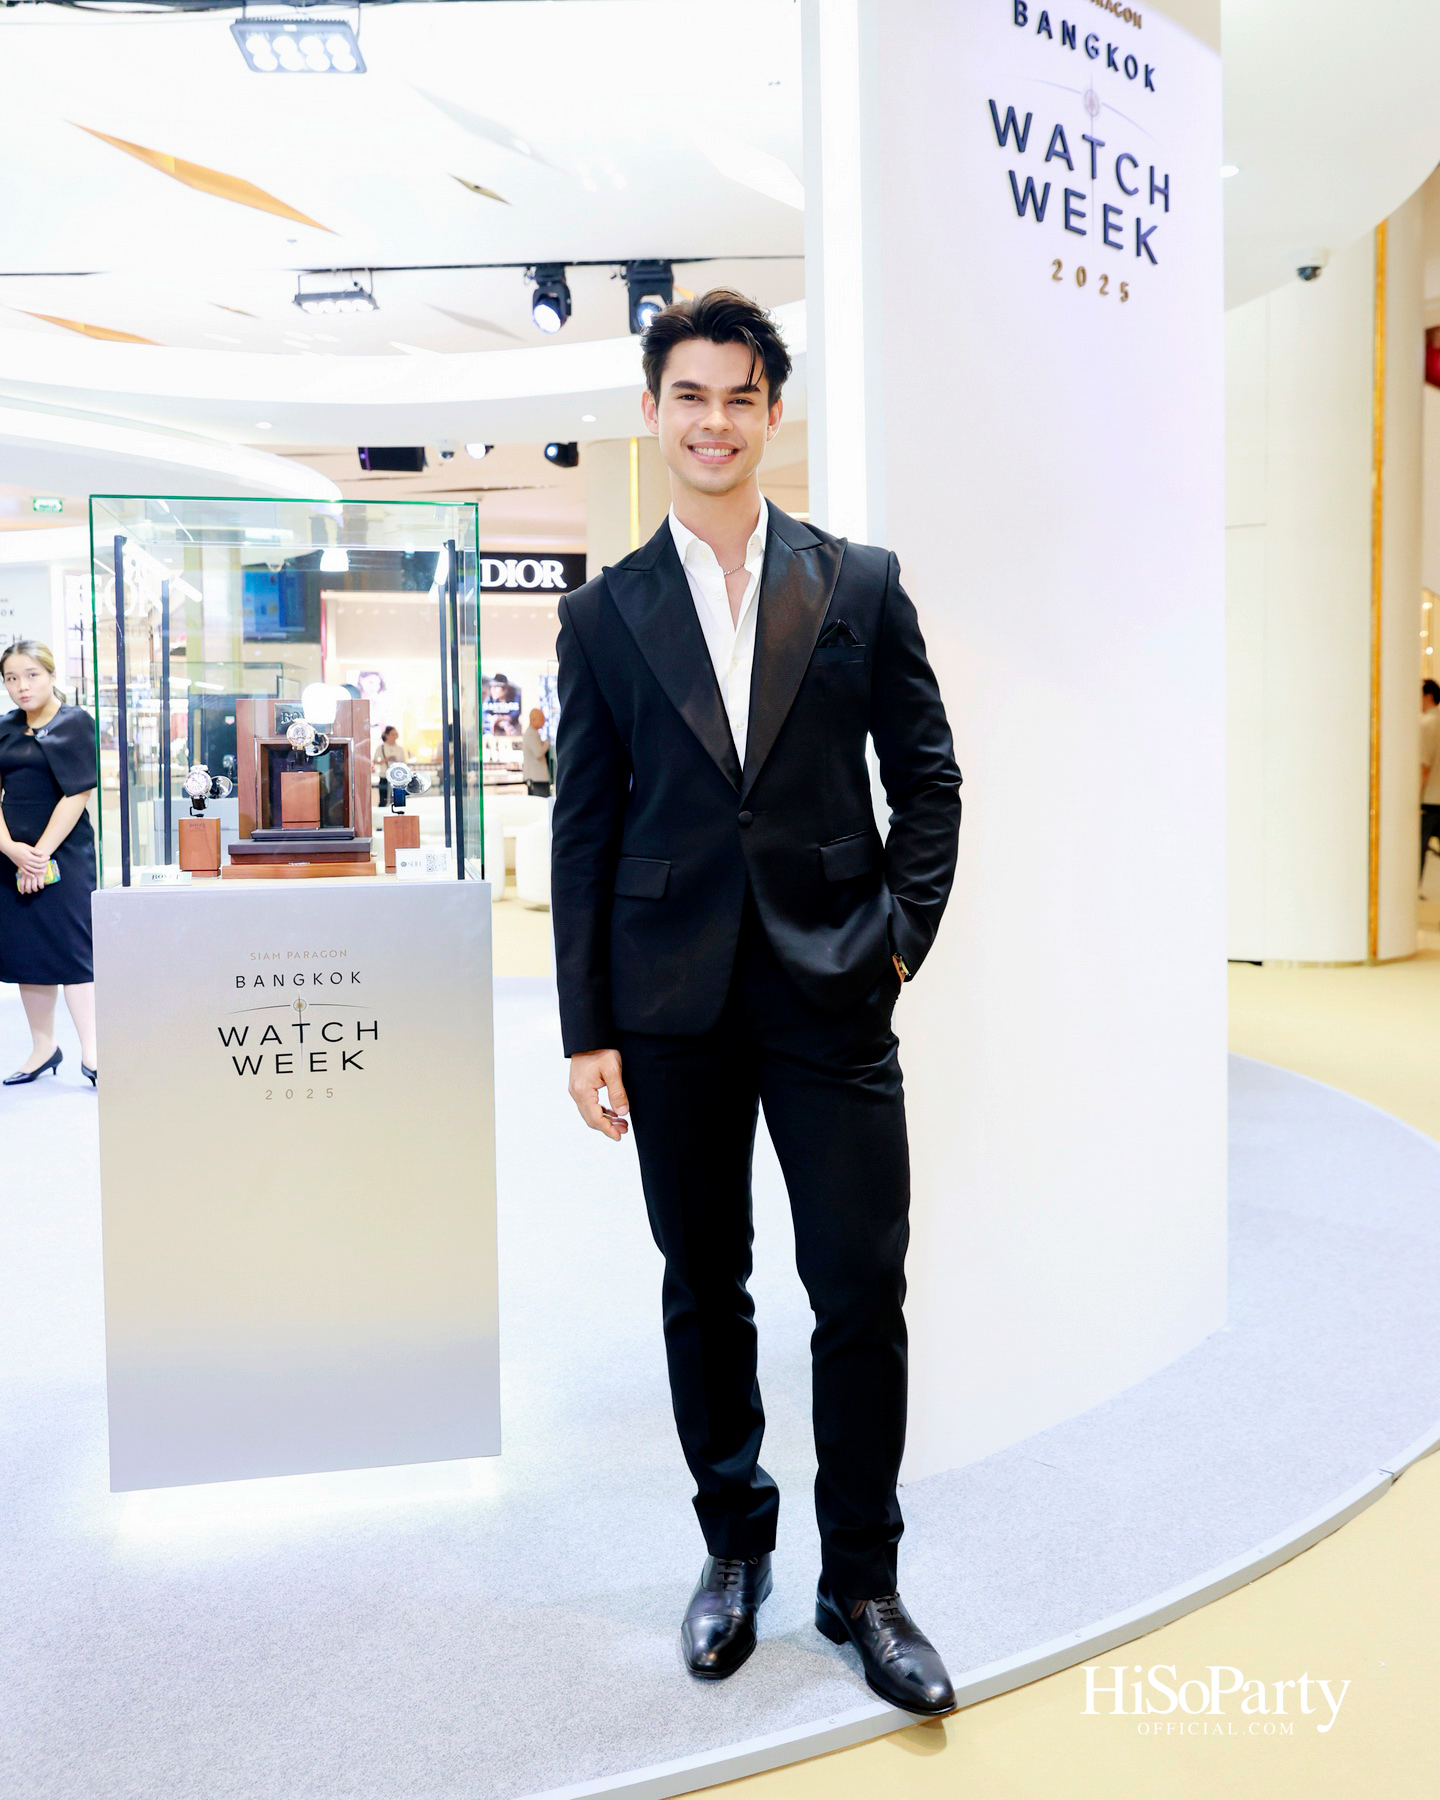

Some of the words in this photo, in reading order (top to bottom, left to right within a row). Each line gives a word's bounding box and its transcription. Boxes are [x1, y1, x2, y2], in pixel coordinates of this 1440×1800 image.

[1090, 0, 1142, 29] AGON
[1013, 0, 1155, 92] BANGKOK
[988, 98, 1169, 212] WATCH
[1008, 169, 1158, 265] WEEK
[1051, 258, 1129, 302] 2025
[480, 558, 568, 589] DIOR
[250, 952, 281, 961] SIAM
[287, 949, 348, 959] PARAGON
[235, 970, 361, 989] BANGKOK
[217, 1020, 378, 1047] WATCH
[232, 1049, 365, 1076] WEEK
[265, 1087, 334, 1100] 2025
